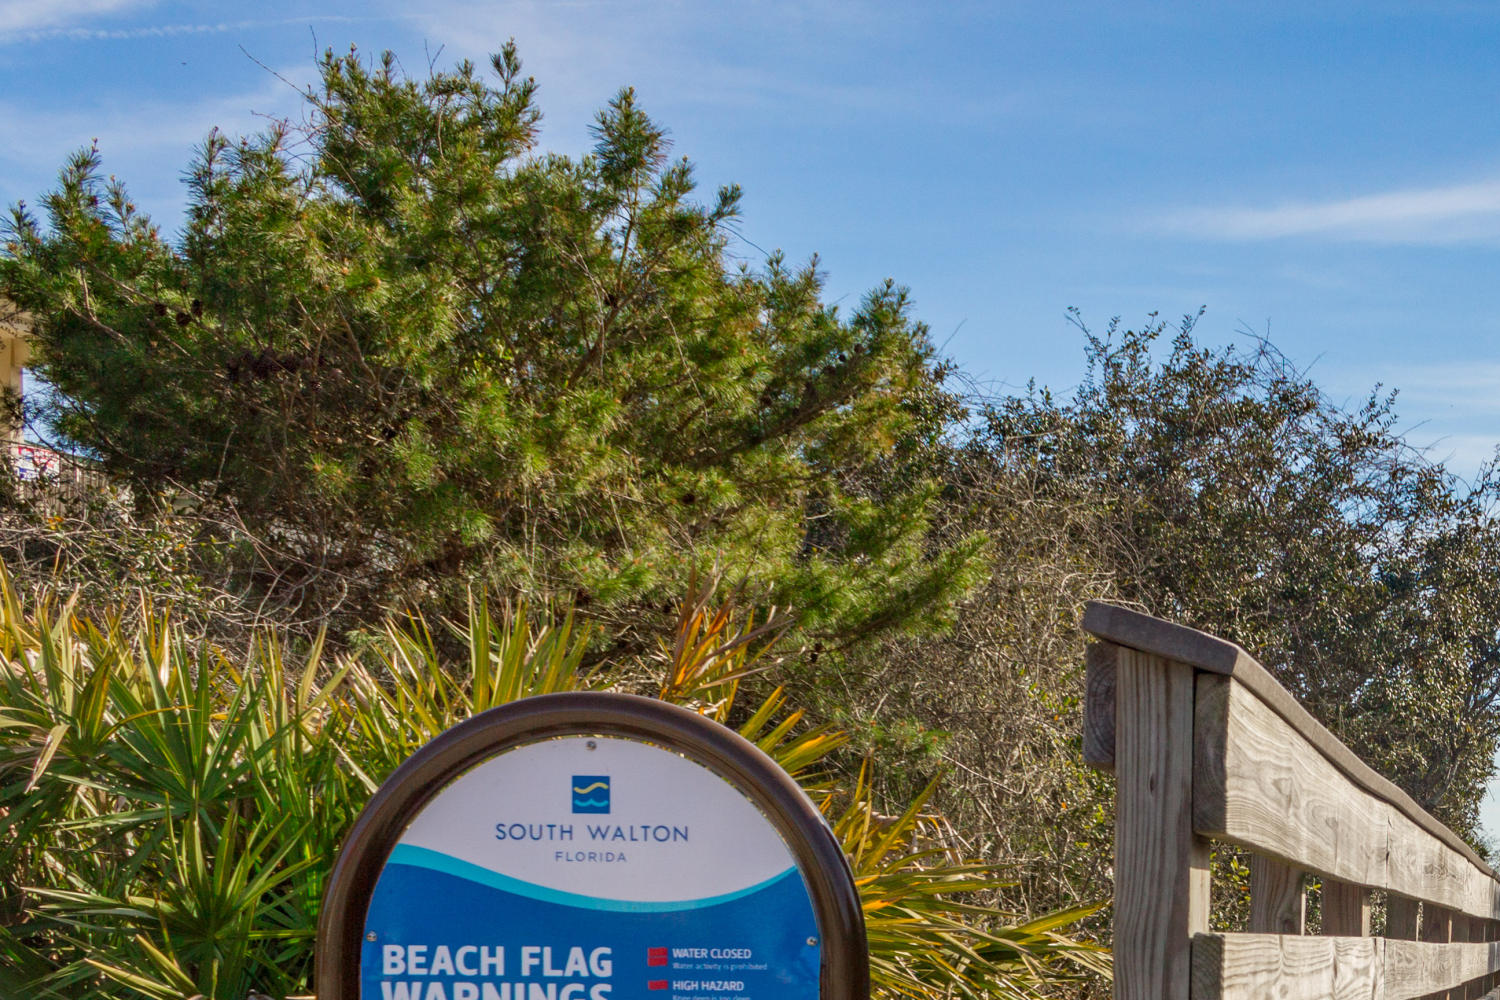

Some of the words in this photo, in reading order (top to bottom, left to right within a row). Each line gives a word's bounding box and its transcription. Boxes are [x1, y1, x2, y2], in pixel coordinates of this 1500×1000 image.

[495, 823, 573, 841] SOUTH
[587, 824, 689, 842] WALTON
[555, 851, 627, 863] FLORIDA
[672, 948, 708, 959] WATER
[710, 948, 752, 959] CLOSED
[382, 944, 505, 976] BEACH
[521, 946, 613, 977] FLAG
[672, 980, 699, 991] HIGH
[701, 981, 745, 991] HAZARD
